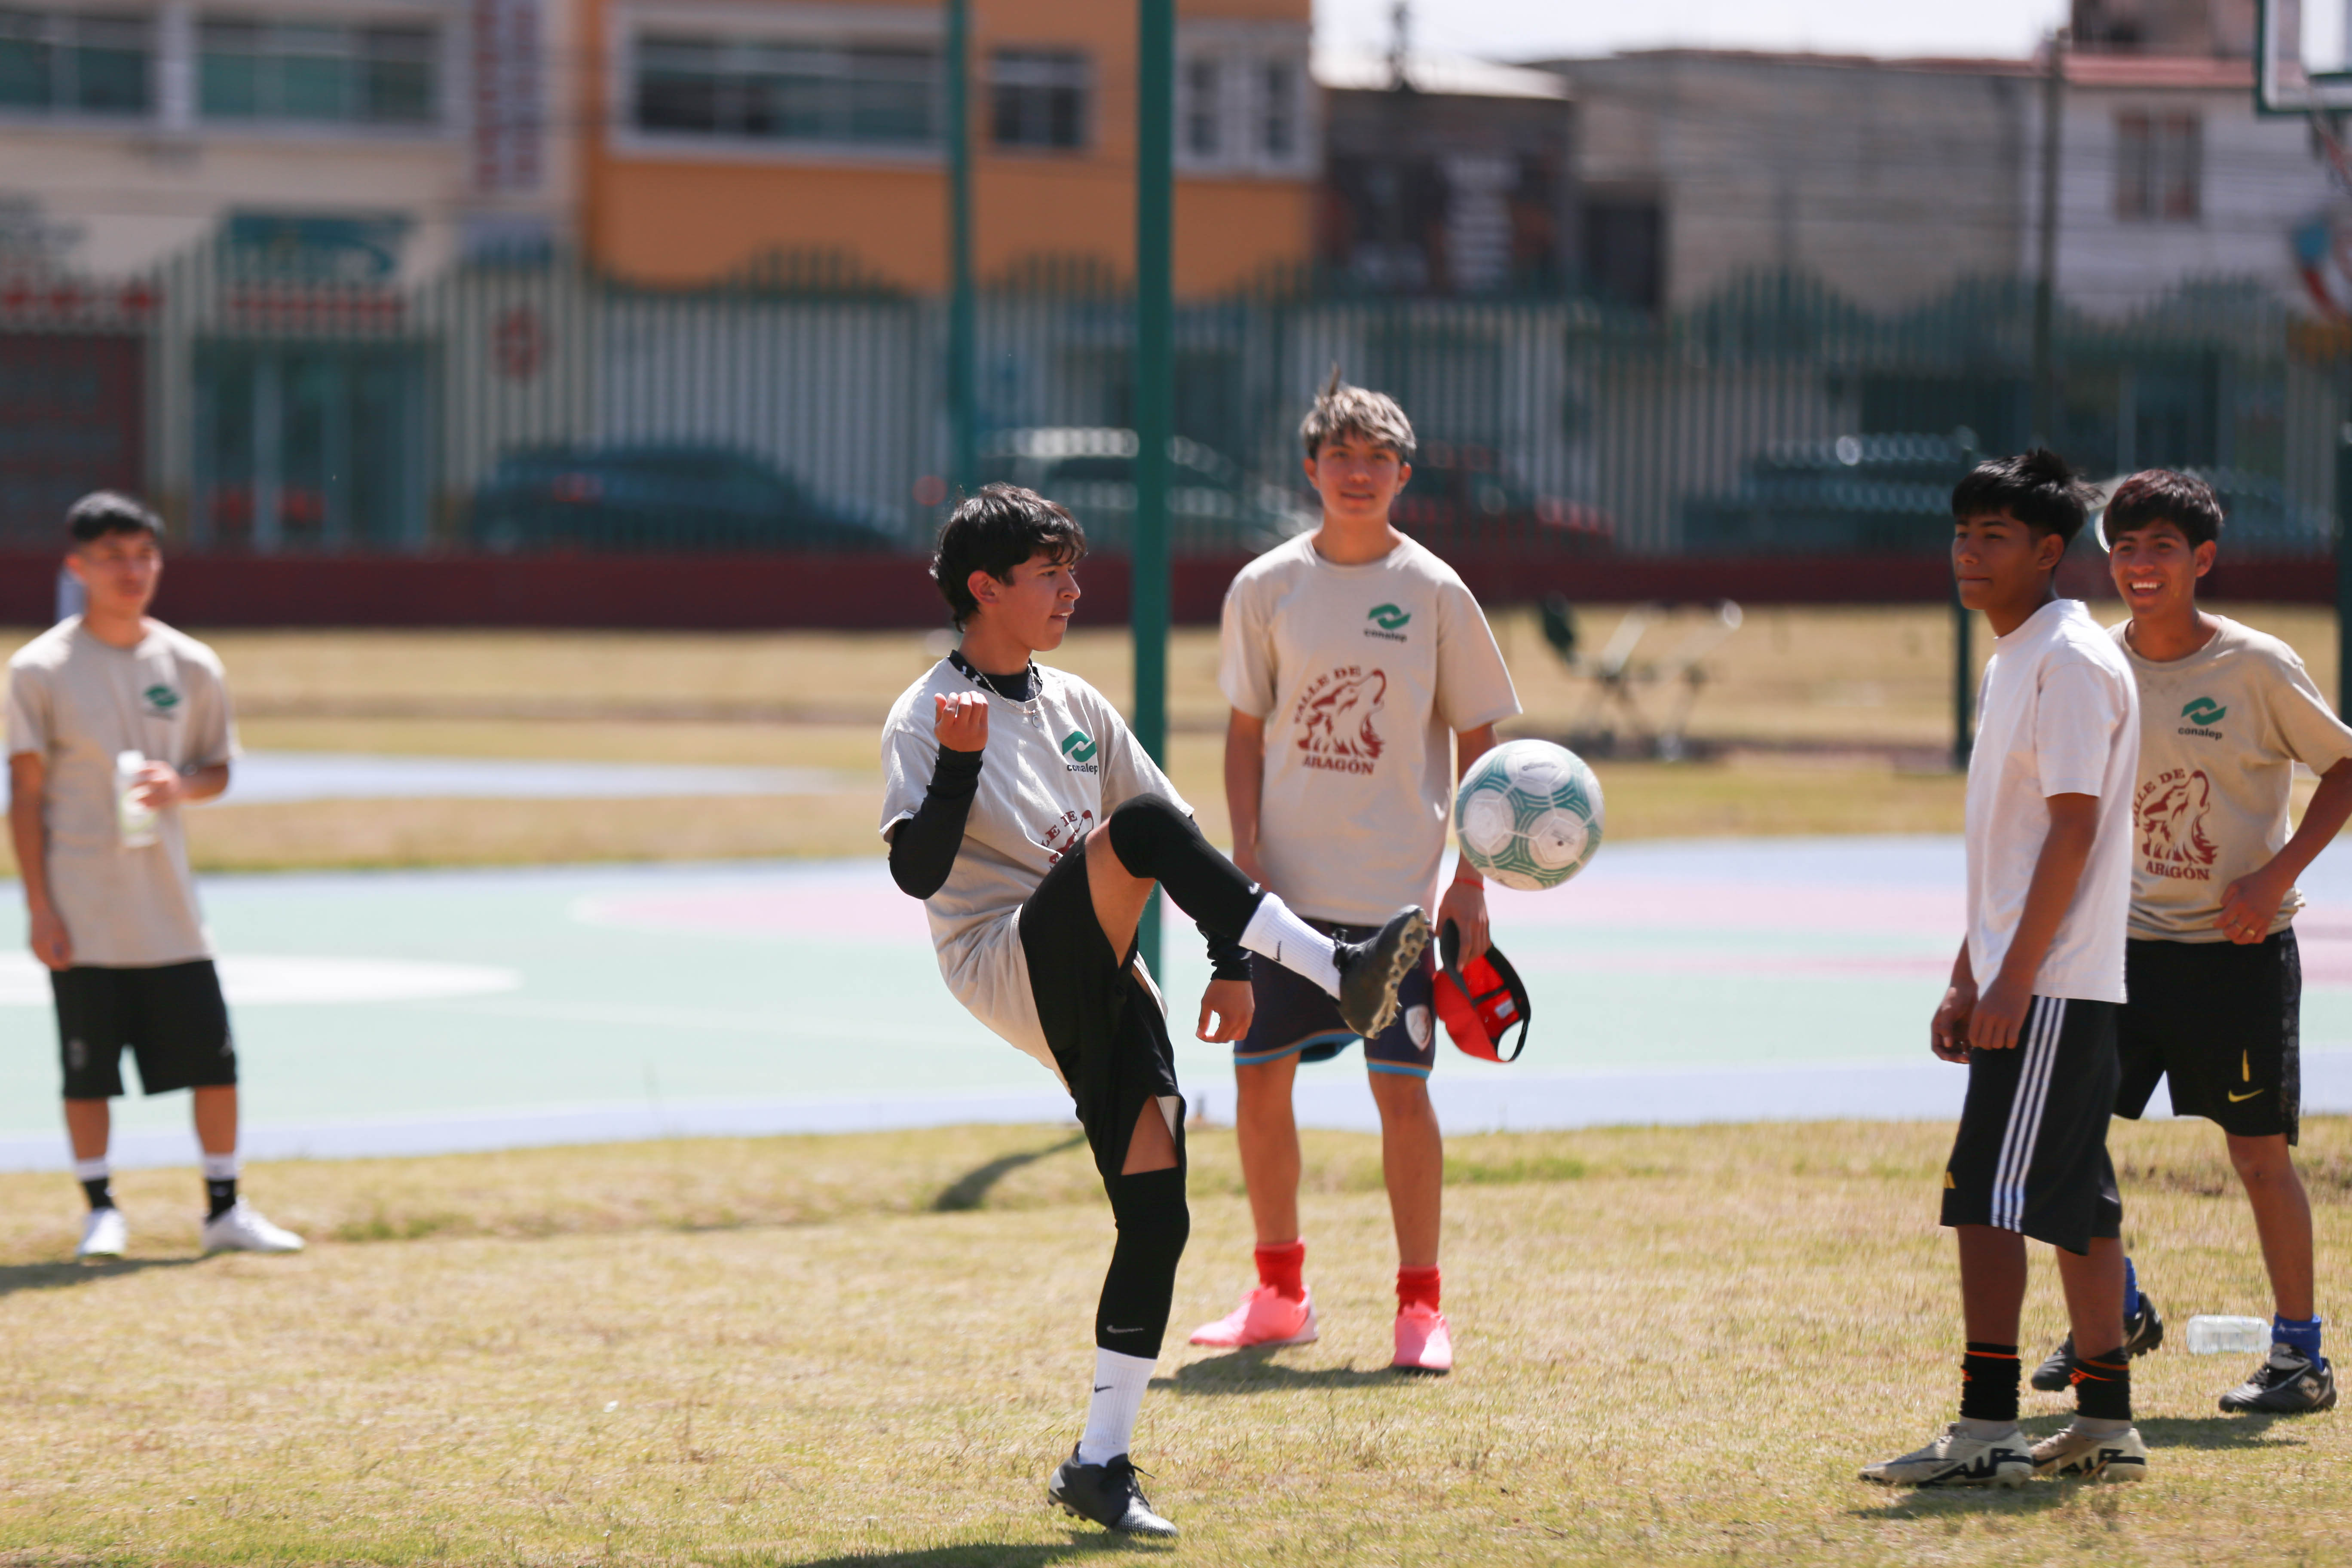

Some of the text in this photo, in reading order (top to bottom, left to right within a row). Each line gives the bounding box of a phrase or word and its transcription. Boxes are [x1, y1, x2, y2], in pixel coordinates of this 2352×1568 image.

[1334, 665, 1360, 680] DE
[2177, 727, 2223, 741] conalep
[1066, 763, 1098, 775] conalep
[2159, 768, 2185, 784] DE
